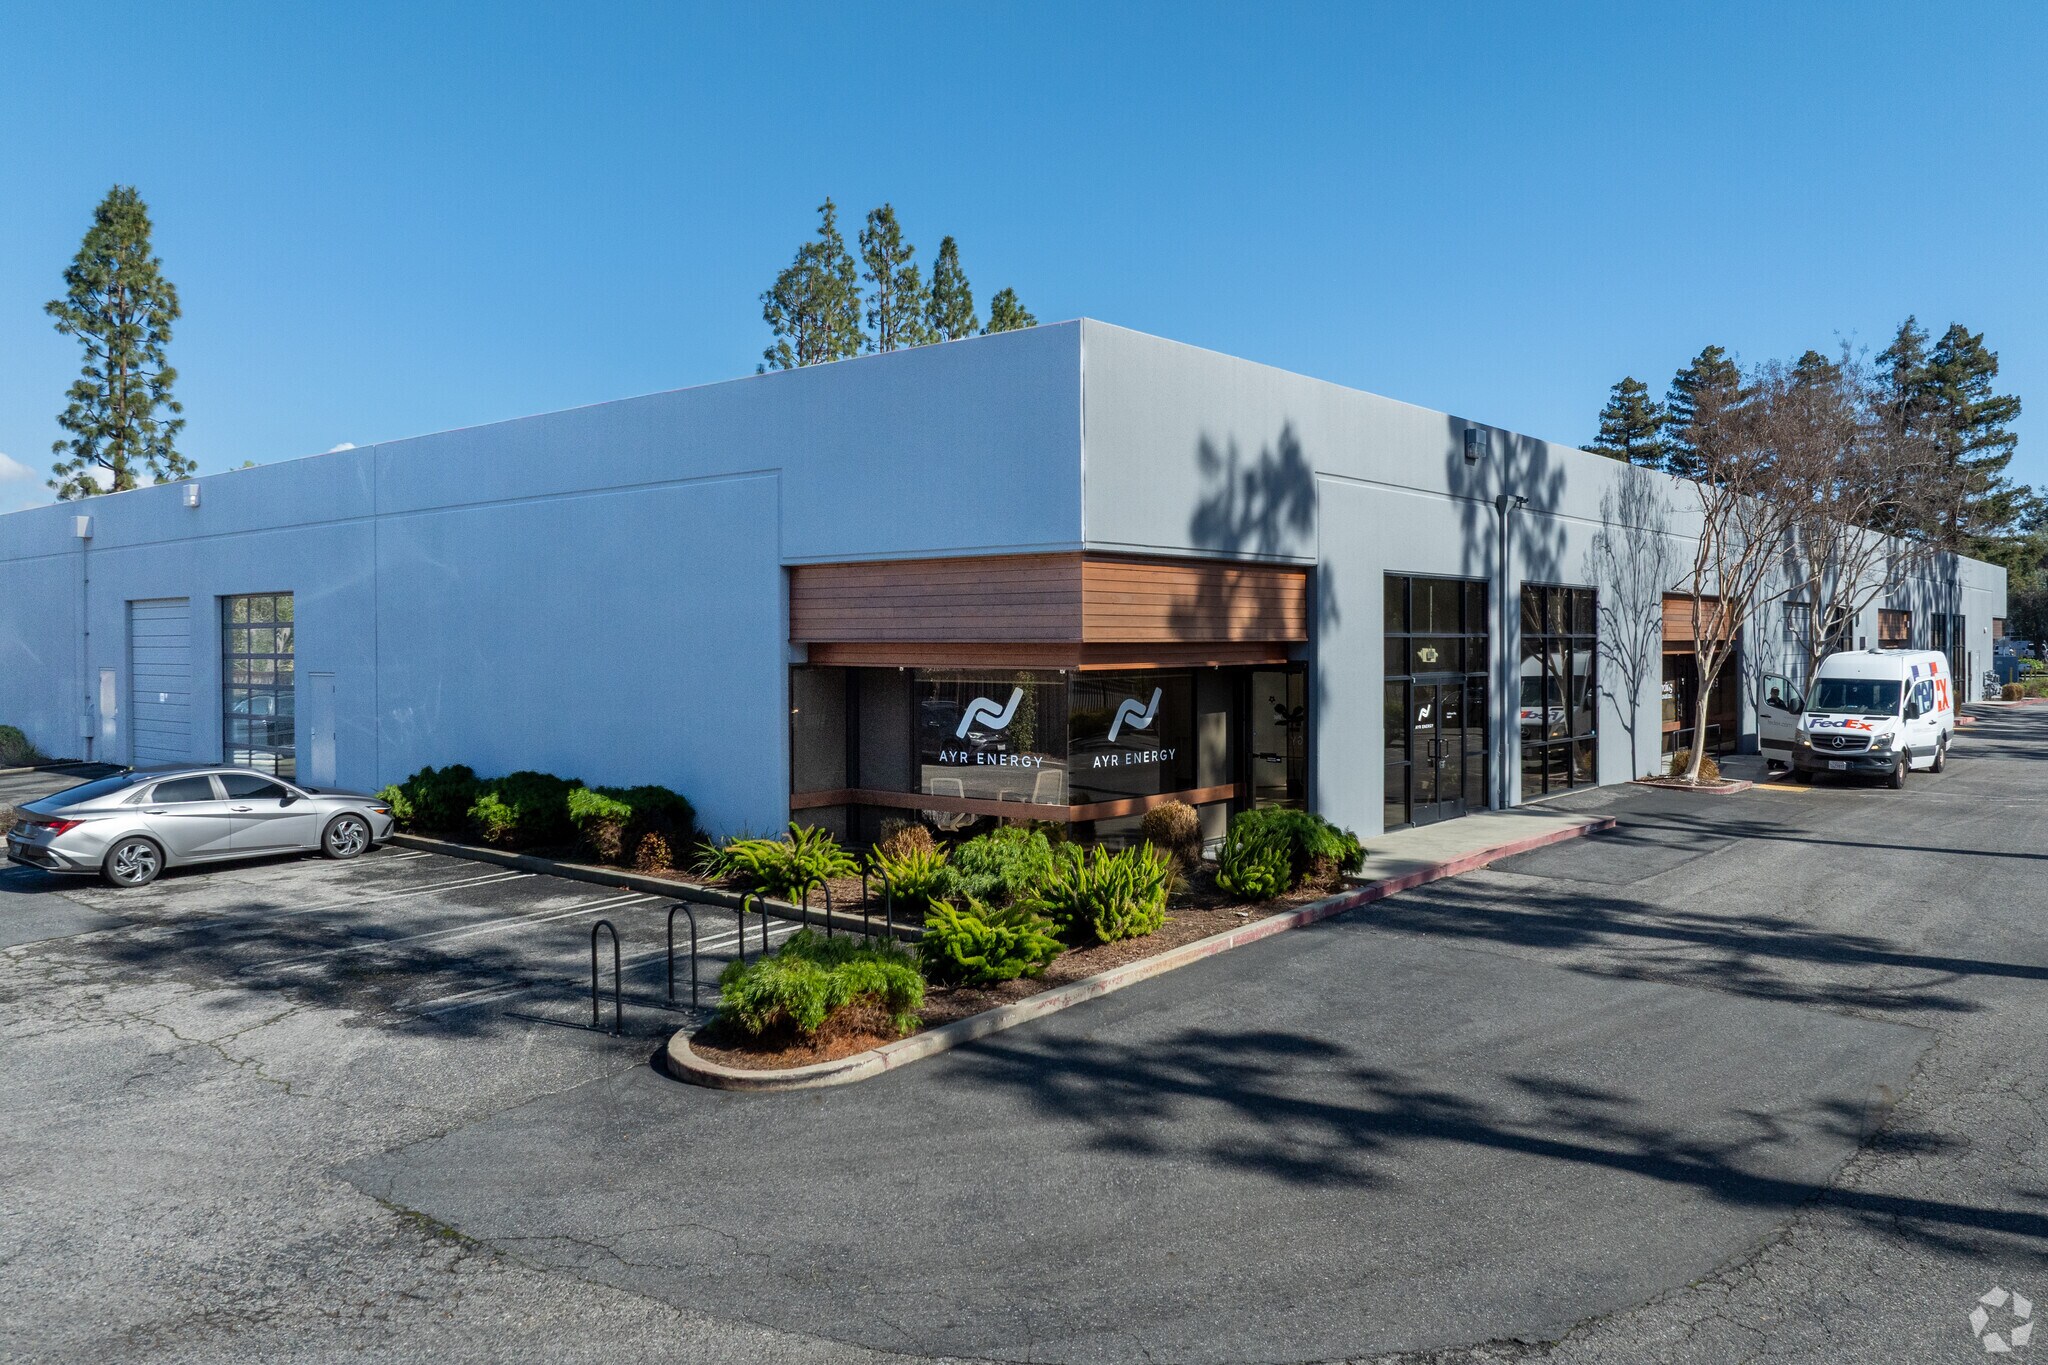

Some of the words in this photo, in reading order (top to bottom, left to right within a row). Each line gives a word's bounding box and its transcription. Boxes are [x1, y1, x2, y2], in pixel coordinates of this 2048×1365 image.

[1809, 719, 1874, 731] FedEx
[939, 751, 968, 763] AYR
[977, 753, 1043, 768] ENERGY
[1093, 755, 1118, 768] AYR
[1125, 748, 1176, 765] ENERGY
